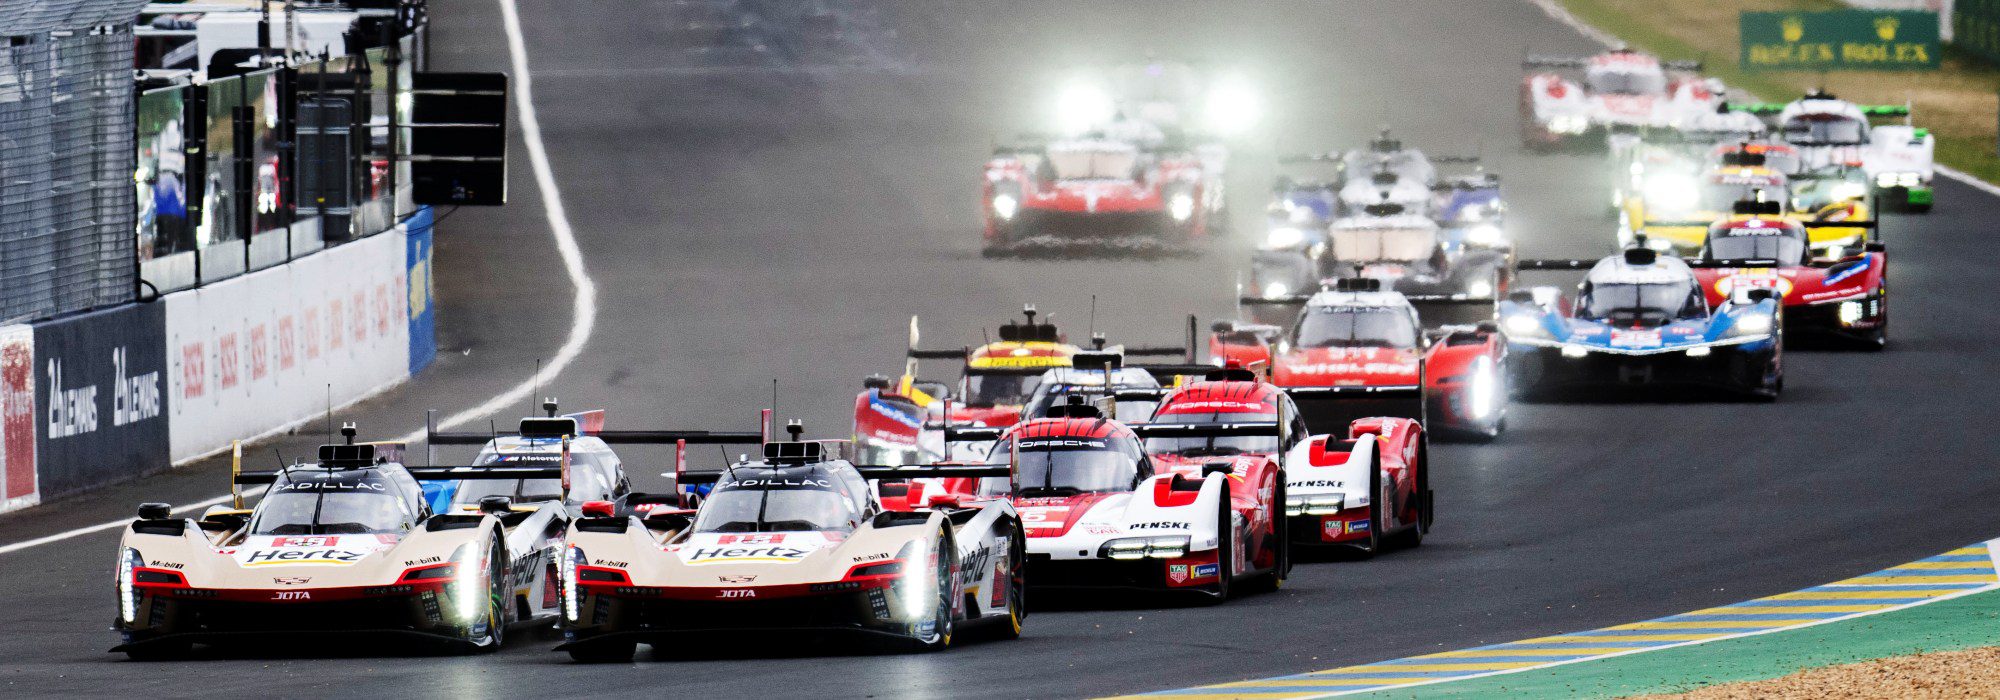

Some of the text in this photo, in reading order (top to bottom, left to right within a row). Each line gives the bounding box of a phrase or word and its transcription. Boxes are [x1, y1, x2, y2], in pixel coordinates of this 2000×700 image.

[1842, 43, 1928, 62] ROLEX
[1169, 401, 1262, 410] PORSCHE
[272, 482, 386, 492] CADILLAC
[716, 479, 832, 490] CADILLAC
[1286, 479, 1345, 488] PENSKE
[1129, 521, 1193, 530] PENSKE
[247, 549, 365, 563] Hertz
[690, 546, 811, 561] Hertz
[405, 558, 432, 567] Mobil
[594, 559, 619, 567] Mobil
[853, 554, 880, 563] Mobil
[151, 560, 176, 568] Mobil
[270, 591, 311, 600] JOTA
[715, 589, 756, 598] JOTA
